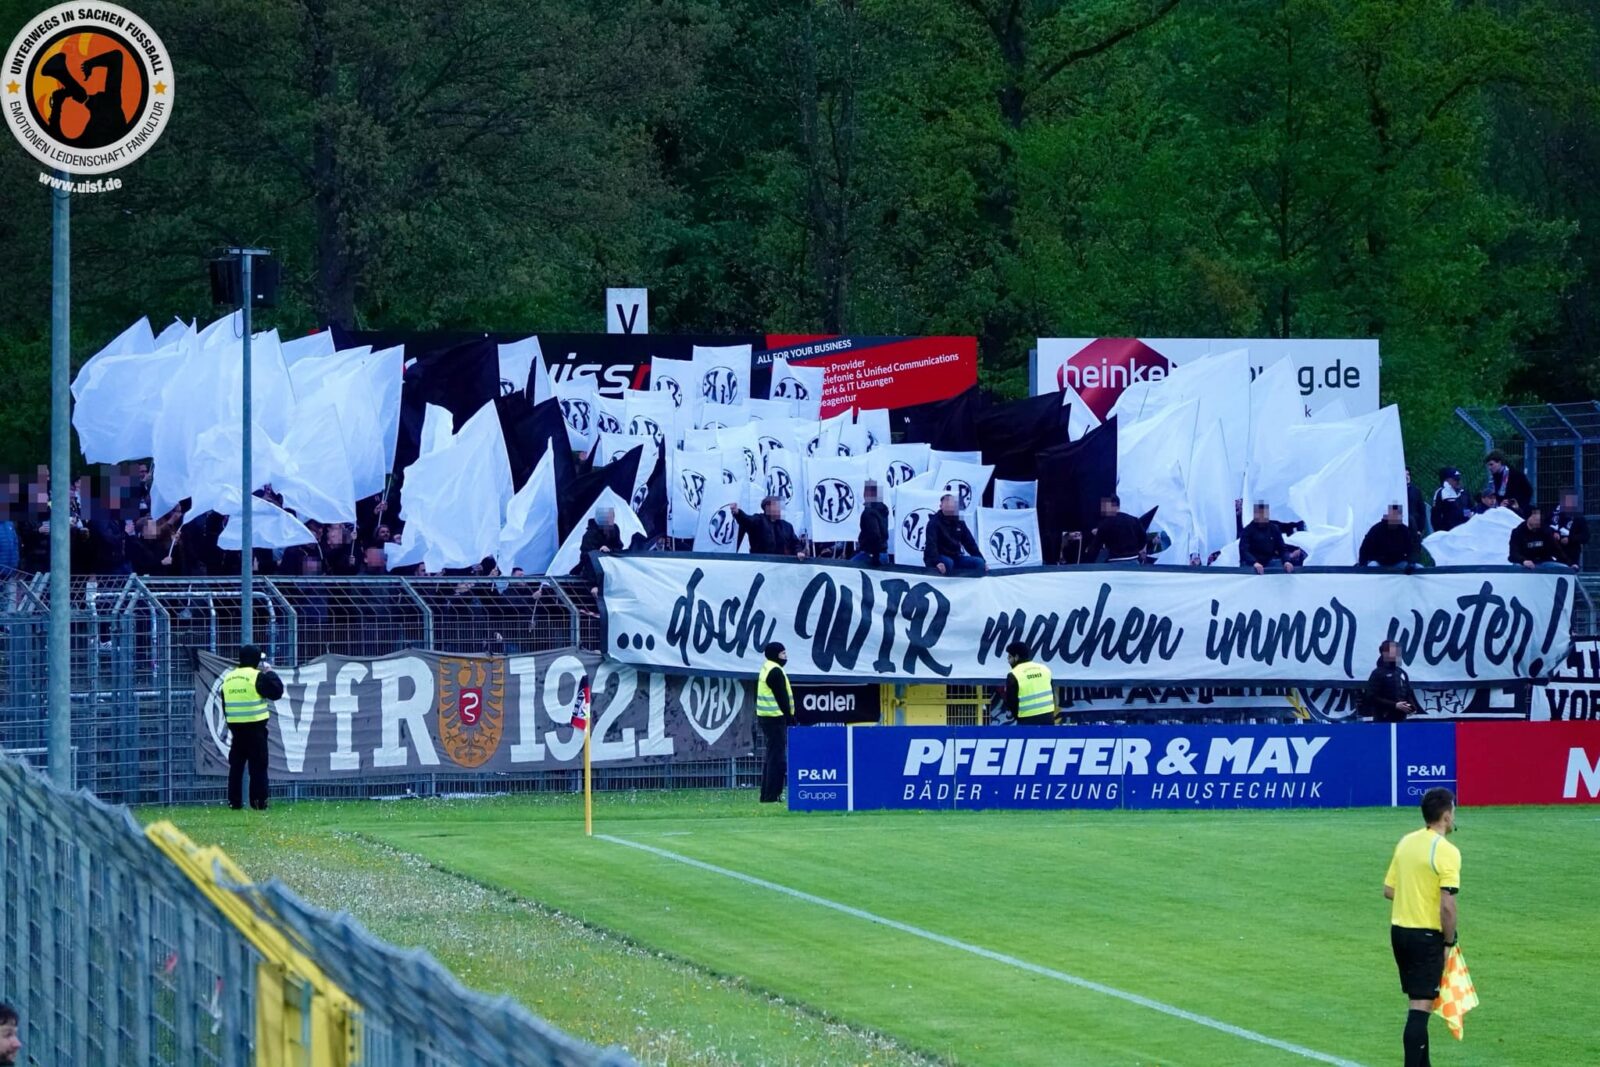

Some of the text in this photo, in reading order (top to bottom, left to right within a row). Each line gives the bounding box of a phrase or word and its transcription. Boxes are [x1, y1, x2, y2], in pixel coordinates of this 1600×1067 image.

[757, 355, 772, 365] ALL
[789, 347, 814, 358] YOUR
[814, 339, 852, 354] BUSINESS
[823, 353, 959, 385] elefonie & Unified Communications
[831, 360, 866, 372] Provider
[822, 376, 894, 396] erk & IT Lösungen
[822, 394, 857, 407] eagentur
[666, 567, 777, 667] doch
[794, 570, 953, 677] WIR
[977, 582, 1184, 667] machen
[1206, 596, 1357, 679] immer
[1387, 577, 1568, 678] weiter!
[802, 690, 857, 713] aalen
[272, 655, 675, 773] VfR 1921
[903, 736, 1332, 776] PFEIFFER & MAY
[798, 768, 837, 780] P&M
[1407, 764, 1446, 776] P&M
[798, 790, 837, 801] Gruppe
[903, 780, 1324, 801] BÄDER HEIZUNG HAUSTECHNIK
